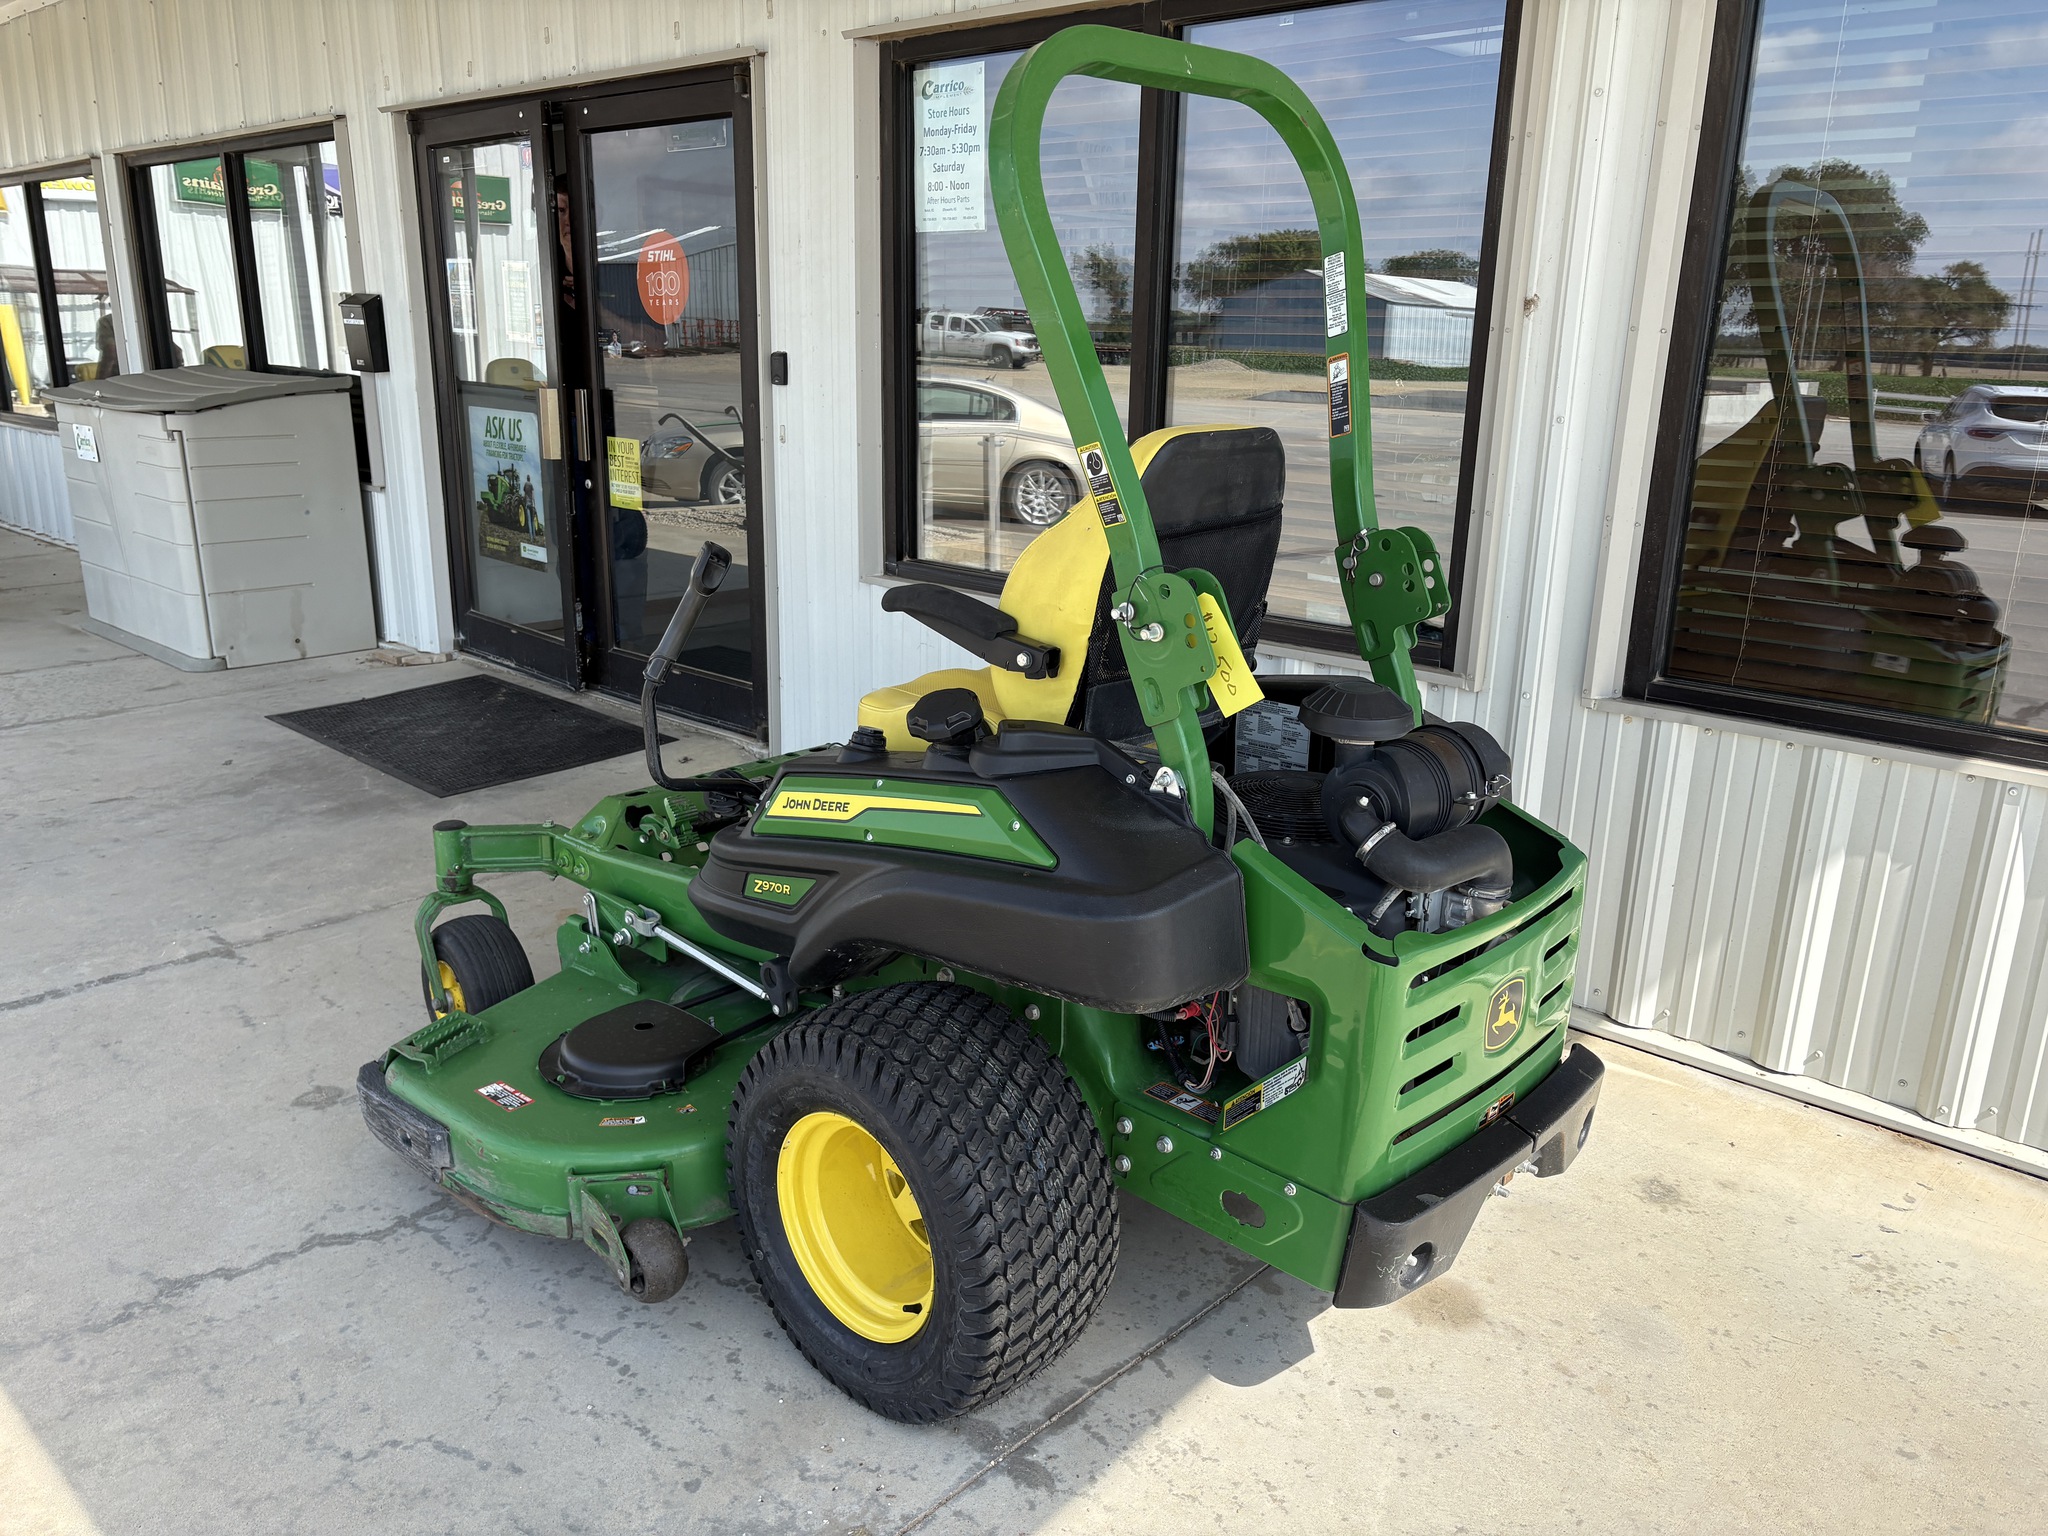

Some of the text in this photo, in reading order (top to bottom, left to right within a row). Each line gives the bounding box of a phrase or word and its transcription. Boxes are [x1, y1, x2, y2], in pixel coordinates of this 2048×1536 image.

[921, 79, 965, 100] Carrico
[928, 106, 970, 119] Store Hours
[923, 122, 977, 138] Monday-Friday
[919, 145, 946, 156] 7:30am
[951, 142, 980, 156] 5:30pm
[932, 160, 966, 174] Saturday
[927, 181, 943, 192] 8:00
[949, 180, 970, 191] Noon
[926, 195, 970, 205] After Hours Parts
[647, 249, 676, 262] STIHL
[645, 270, 680, 297] 100
[648, 298, 679, 306] YEARS
[485, 415, 522, 442] ASK US
[608, 440, 635, 456] IN YOUR
[609, 454, 625, 468] BEST
[609, 468, 640, 484] INTEREST
[782, 797, 850, 813] JOHN DEERE
[753, 879, 791, 895] Z970R
